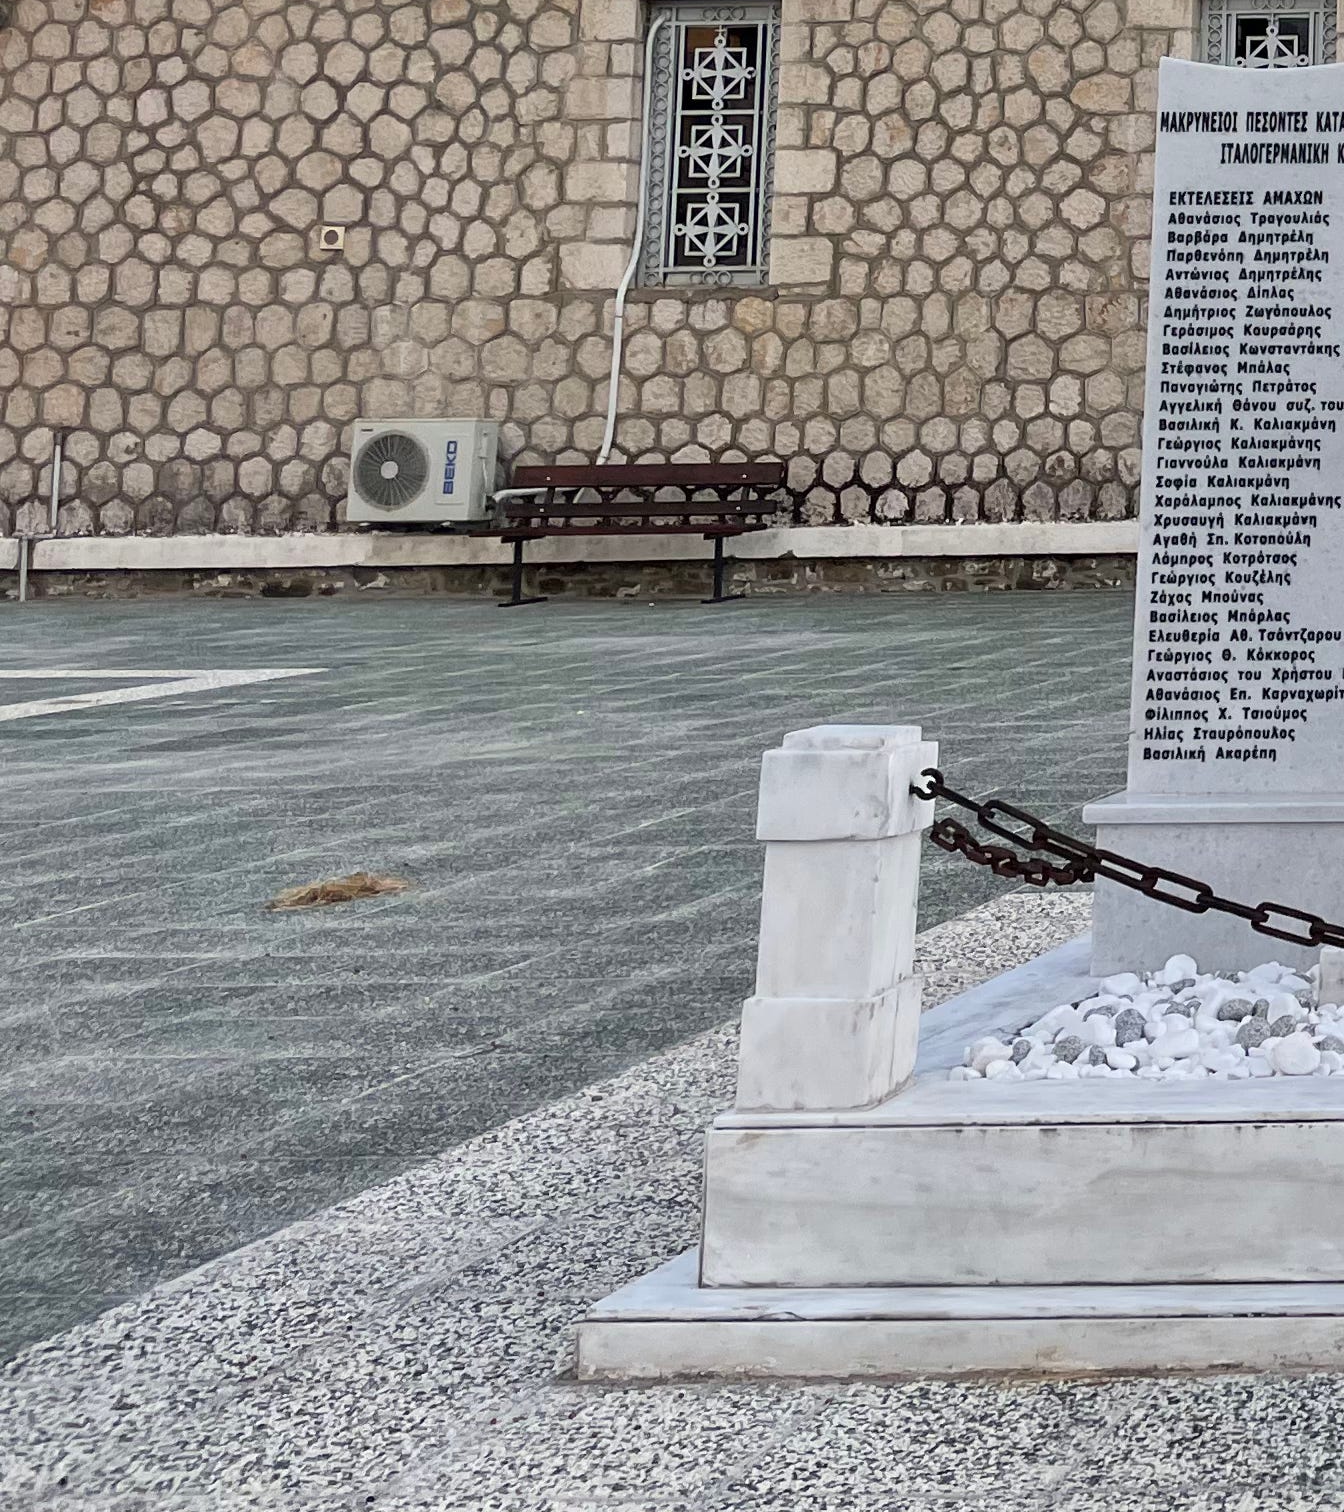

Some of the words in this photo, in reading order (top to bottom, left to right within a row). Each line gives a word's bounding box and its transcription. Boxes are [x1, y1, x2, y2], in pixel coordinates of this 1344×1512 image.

[1160, 111, 1238, 133] ΜΑΚΡΥΝΕΙΟΙ
[1245, 111, 1309, 133] ΠΕΣΟΝΤΕΣ
[1220, 142, 1330, 165] ΙΤΑΛΟΓΕΡΜΑΝΙΚΗ
[1169, 190, 1254, 206] ΕΚΤΕΛΕΣΕΙΣ
[1262, 190, 1323, 205] ΑΜΑΧΩΝ
[1167, 210, 1241, 228] Αθανάσιος
[1250, 210, 1330, 228] Τραγουλιάς
[1167, 229, 1229, 247] Βαρβάρα
[1238, 229, 1314, 246] Δημητρέλη
[1166, 247, 1244, 265] Παρθενόπη
[1253, 247, 1329, 264] Δημητρέλη
[1165, 266, 1230, 284] Αντώνιος
[1238, 266, 1322, 283] Δημητρέλης
[1164, 285, 1238, 302] Αθανάσιος
[1163, 304, 1236, 321] Δημήτριος
[1245, 303, 1332, 320] Ζωγόπουλος
[1162, 341, 1230, 358] Βασίλειος
[1239, 340, 1341, 358] Κωνσταντάκης
[1161, 360, 1228, 377] Στέφανος
[1160, 378, 1243, 396] Παναγιώτης
[1158, 397, 1222, 415] Αγγελική
[1232, 397, 1277, 412] Θάνου
[1286, 397, 1316, 414] συζ.
[1320, 400, 1344, 411] του
[1158, 416, 1220, 434] Βασιλική
[1230, 417, 1243, 431] Κ.
[1253, 415, 1336, 433] Καλιακμάνη
[1157, 436, 1222, 453] Γεώργιος
[1231, 435, 1321, 453] Καλιακμάνης
[442, 440, 458, 495] BEKO
[1157, 454, 1229, 469] Γιαννούλα
[1238, 453, 1321, 472] Καλιακμάνη
[1155, 474, 1197, 491] Σοφία
[1207, 473, 1290, 491] Καλιακμάνη
[1154, 493, 1242, 510] Χαράλαμπος
[1250, 492, 1342, 510] Καλιακμάνης
[1153, 511, 1225, 530] Χρυσαυγή
[1234, 511, 1317, 529] Καλιακμάνη
[1152, 531, 1197, 549] Αγαθή
[1206, 532, 1229, 546] Σπ.
[1151, 550, 1214, 568] Λάμπρος
[1151, 570, 1216, 587] Γεώργιος
[1201, 588, 1264, 606] Μπούνας
[1149, 608, 1218, 626] Βασίλειος
[1148, 627, 1220, 645] Ελευθερία
[1229, 628, 1253, 642] Αθ.
[1147, 647, 1212, 665] Γεώργιος
[1221, 648, 1237, 662] Θ.
[1146, 667, 1229, 684] Αναστάσιος
[1237, 670, 1262, 681] του
[1271, 665, 1333, 684] Χρήστου
[1145, 686, 1221, 704] Αθανάσιος
[1230, 687, 1252, 701] Επ.
[1144, 706, 1209, 723] Φίλιππος
[1218, 707, 1232, 720] Χ.
[1143, 725, 1184, 743] Ηλίας
[1193, 725, 1296, 743] Σταυρόπουλος
